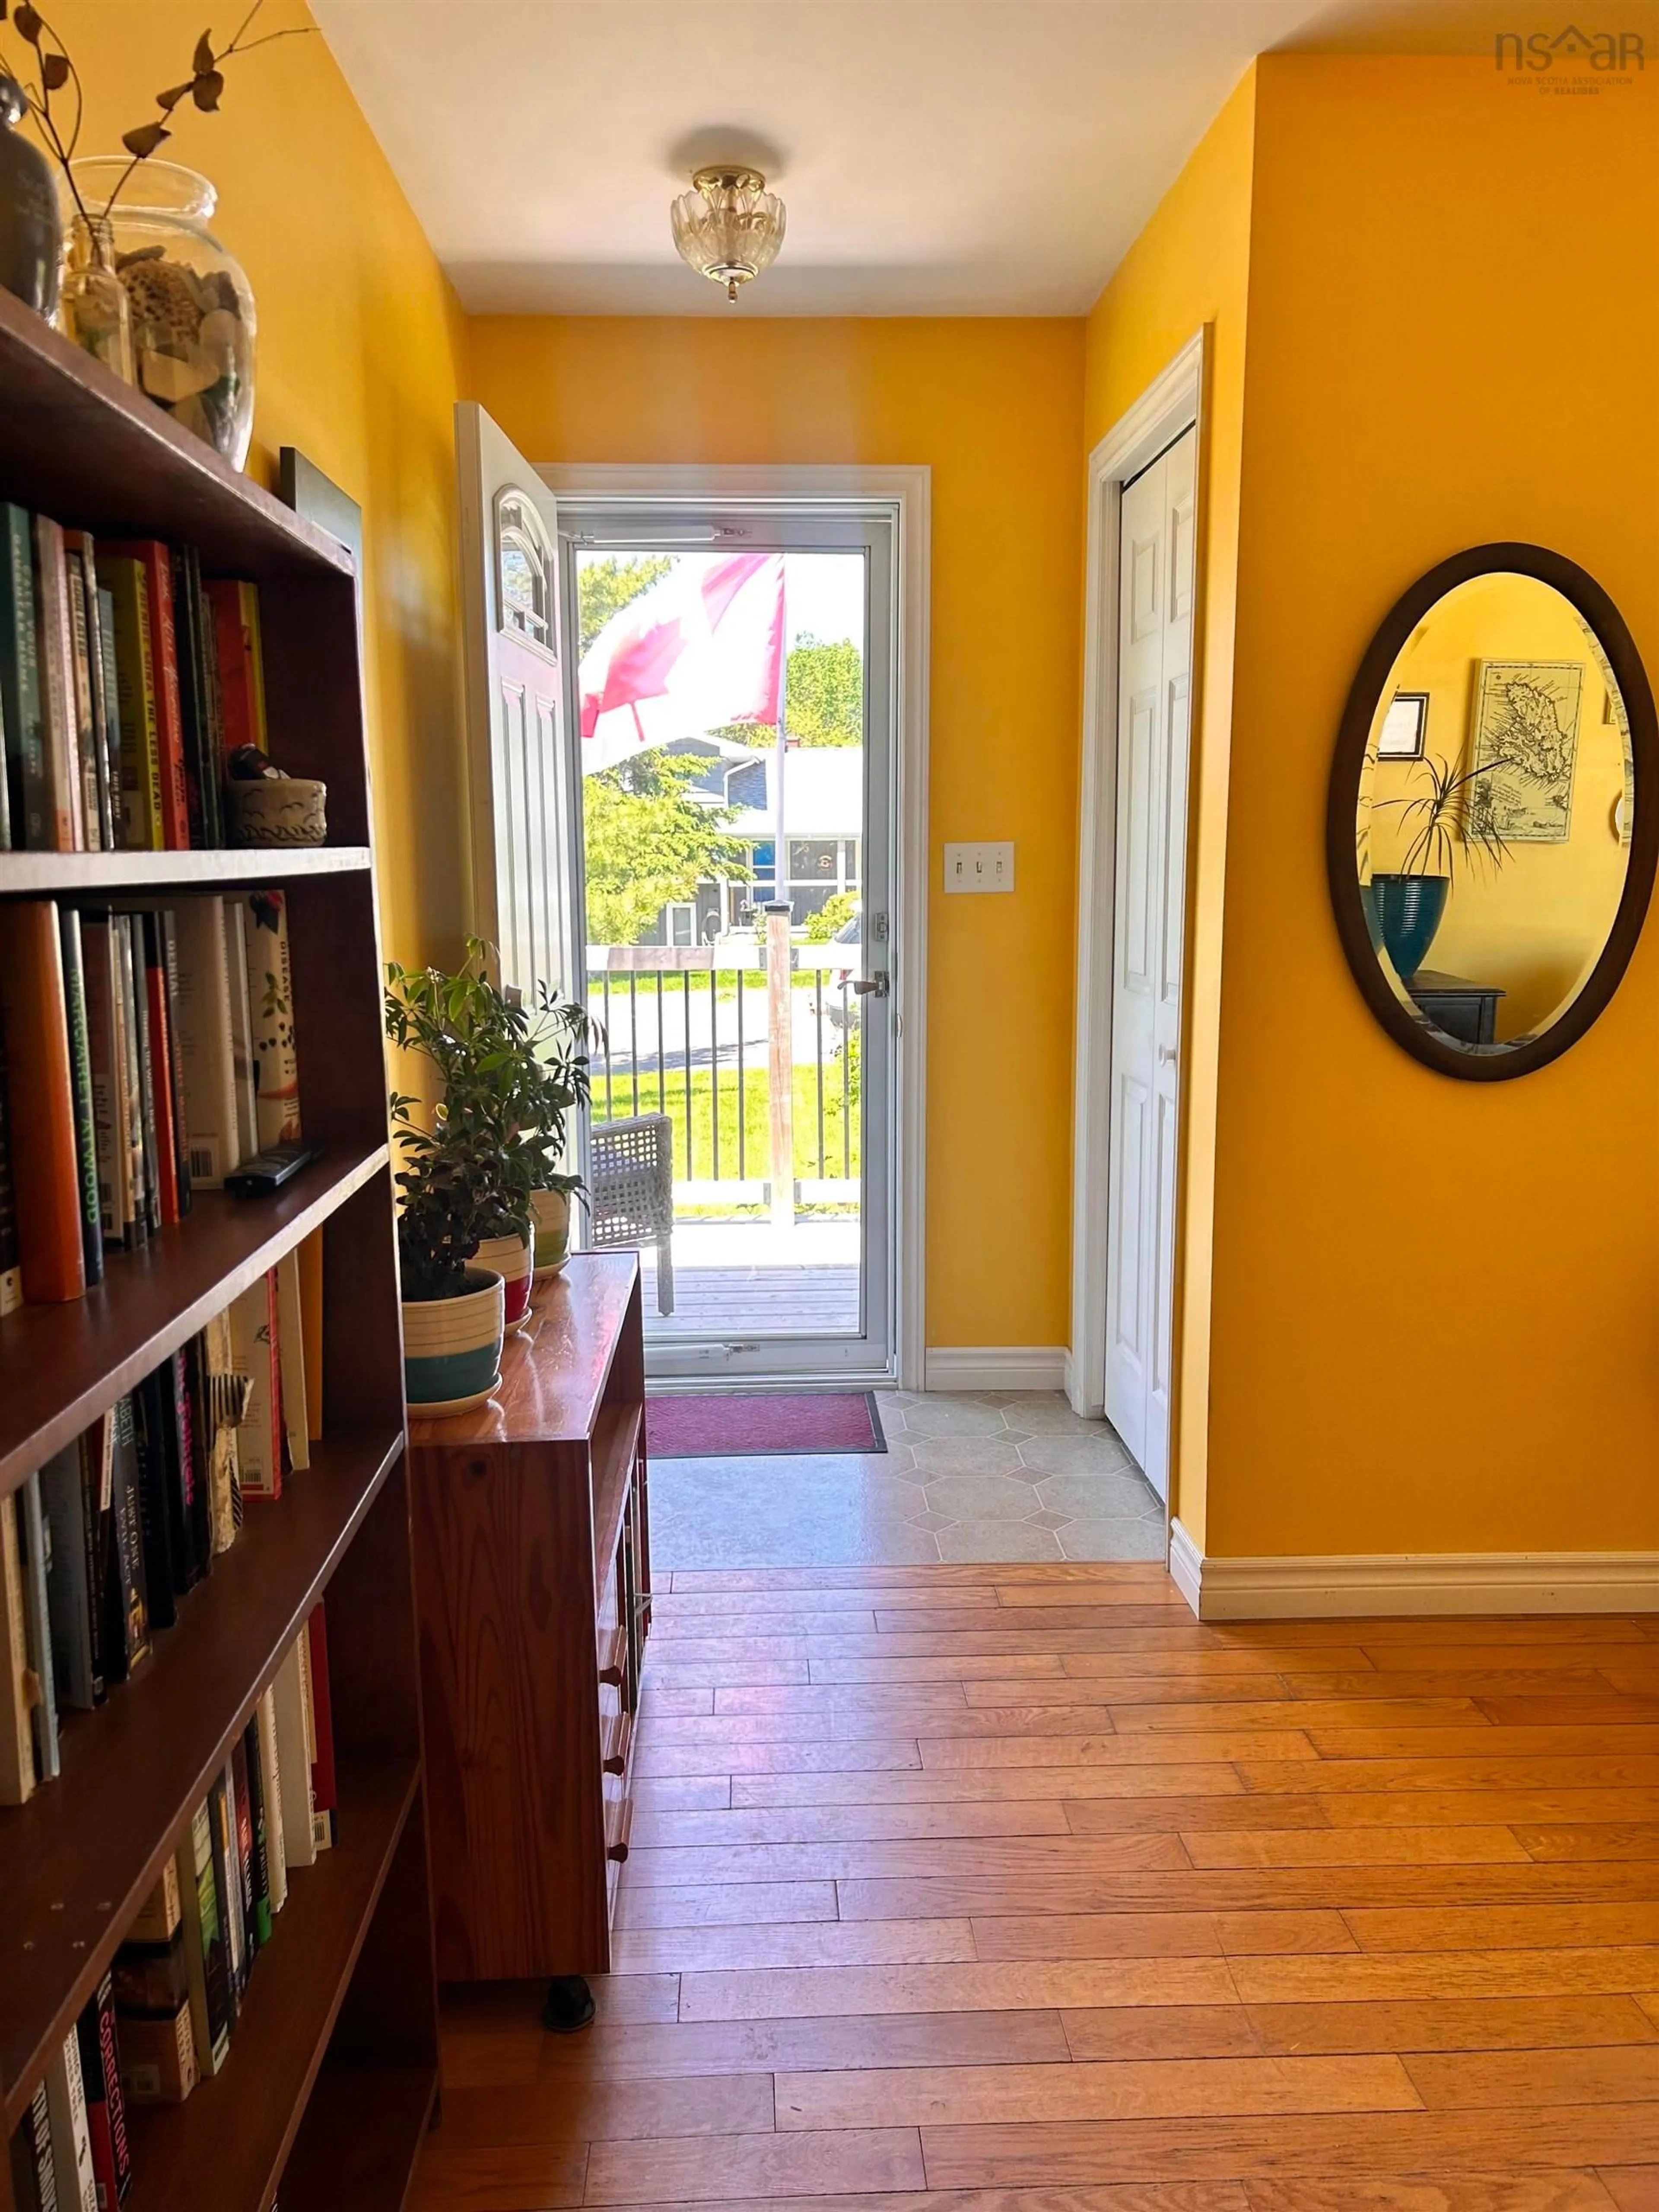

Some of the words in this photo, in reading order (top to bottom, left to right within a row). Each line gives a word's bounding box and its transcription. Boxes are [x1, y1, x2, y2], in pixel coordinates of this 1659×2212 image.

[25, 619, 37, 668] YOUR
[147, 699, 156, 723] THE
[149, 731, 159, 765] LESS
[152, 772, 162, 811] DEAD
[168, 940, 178, 997] DENIAL
[280, 941, 291, 1003] DISEASE
[71, 967, 90, 1104] MARGARET
[80, 1118, 99, 1226] ATWOOD
[125, 1484, 137, 1526] JUST
[129, 1531, 140, 1570] ONE
[99, 2010, 130, 2177] CORRECTIONS
[35, 2116, 50, 2155] OF
